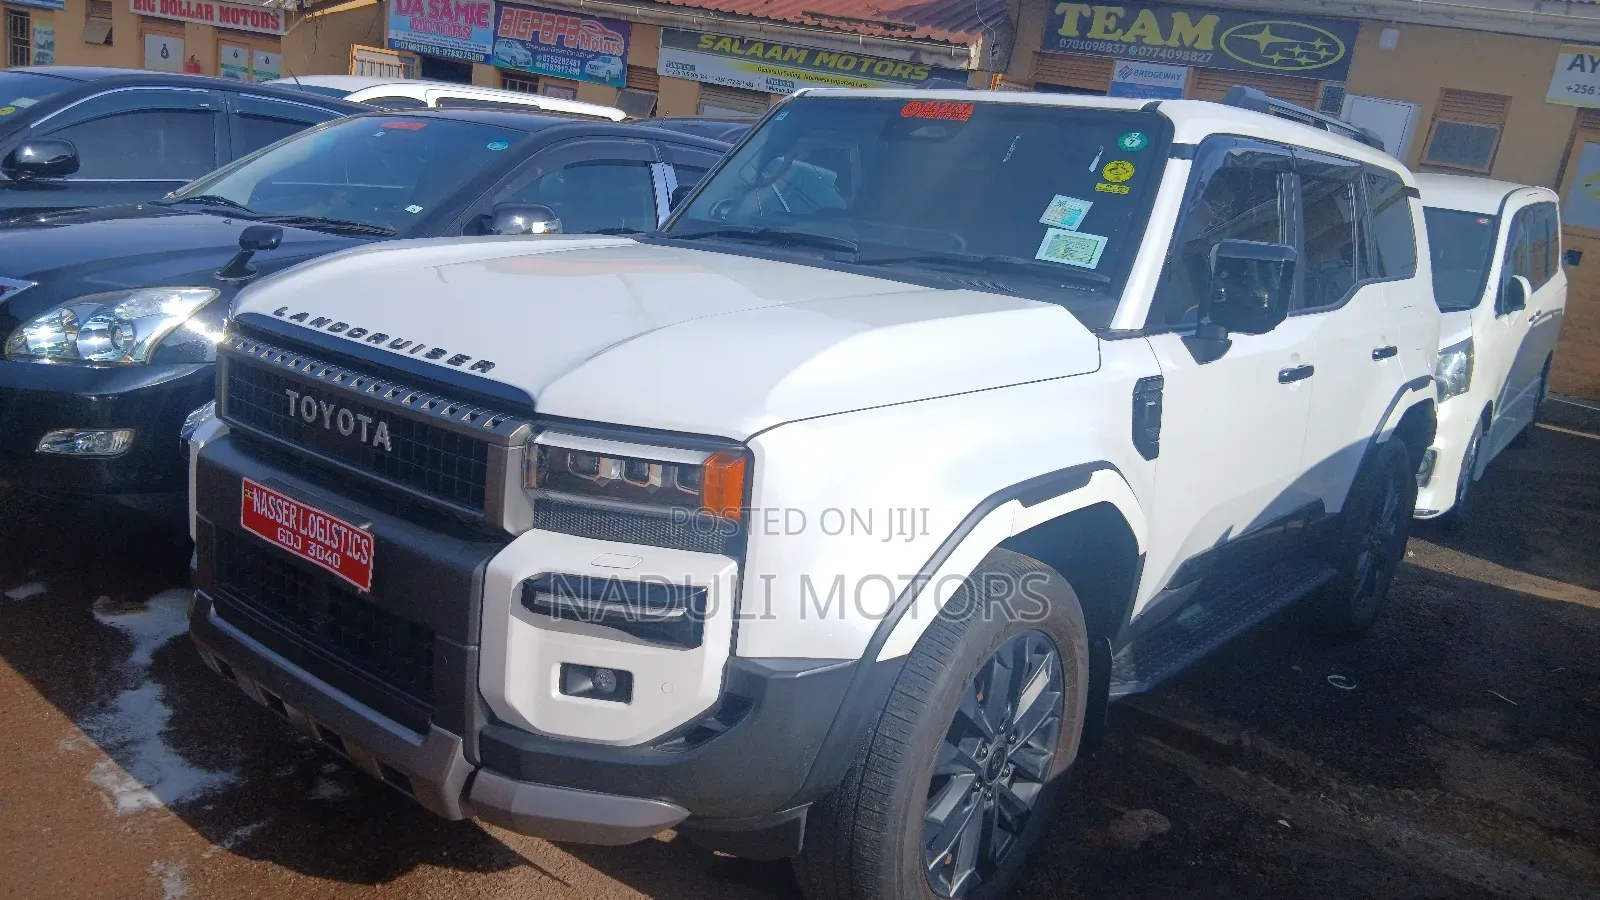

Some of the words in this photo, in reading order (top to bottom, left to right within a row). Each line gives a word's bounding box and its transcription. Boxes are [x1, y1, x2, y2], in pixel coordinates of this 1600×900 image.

[133, 0, 156, 13] BIG
[160, 0, 214, 21] DOLLAR
[218, 5, 280, 31] MOTORS
[410, 17, 472, 40] MOTORS
[1054, 3, 1221, 52] TEAM
[697, 34, 808, 64] SALAAM
[813, 52, 931, 81] MOTORS
[1133, 68, 1182, 81] BRIDGEWAY
[284, 388, 393, 452] TOYOTA
[252, 487, 297, 531] NASSER
[299, 508, 369, 565] LOGISTICS
[277, 527, 302, 551] GDJ
